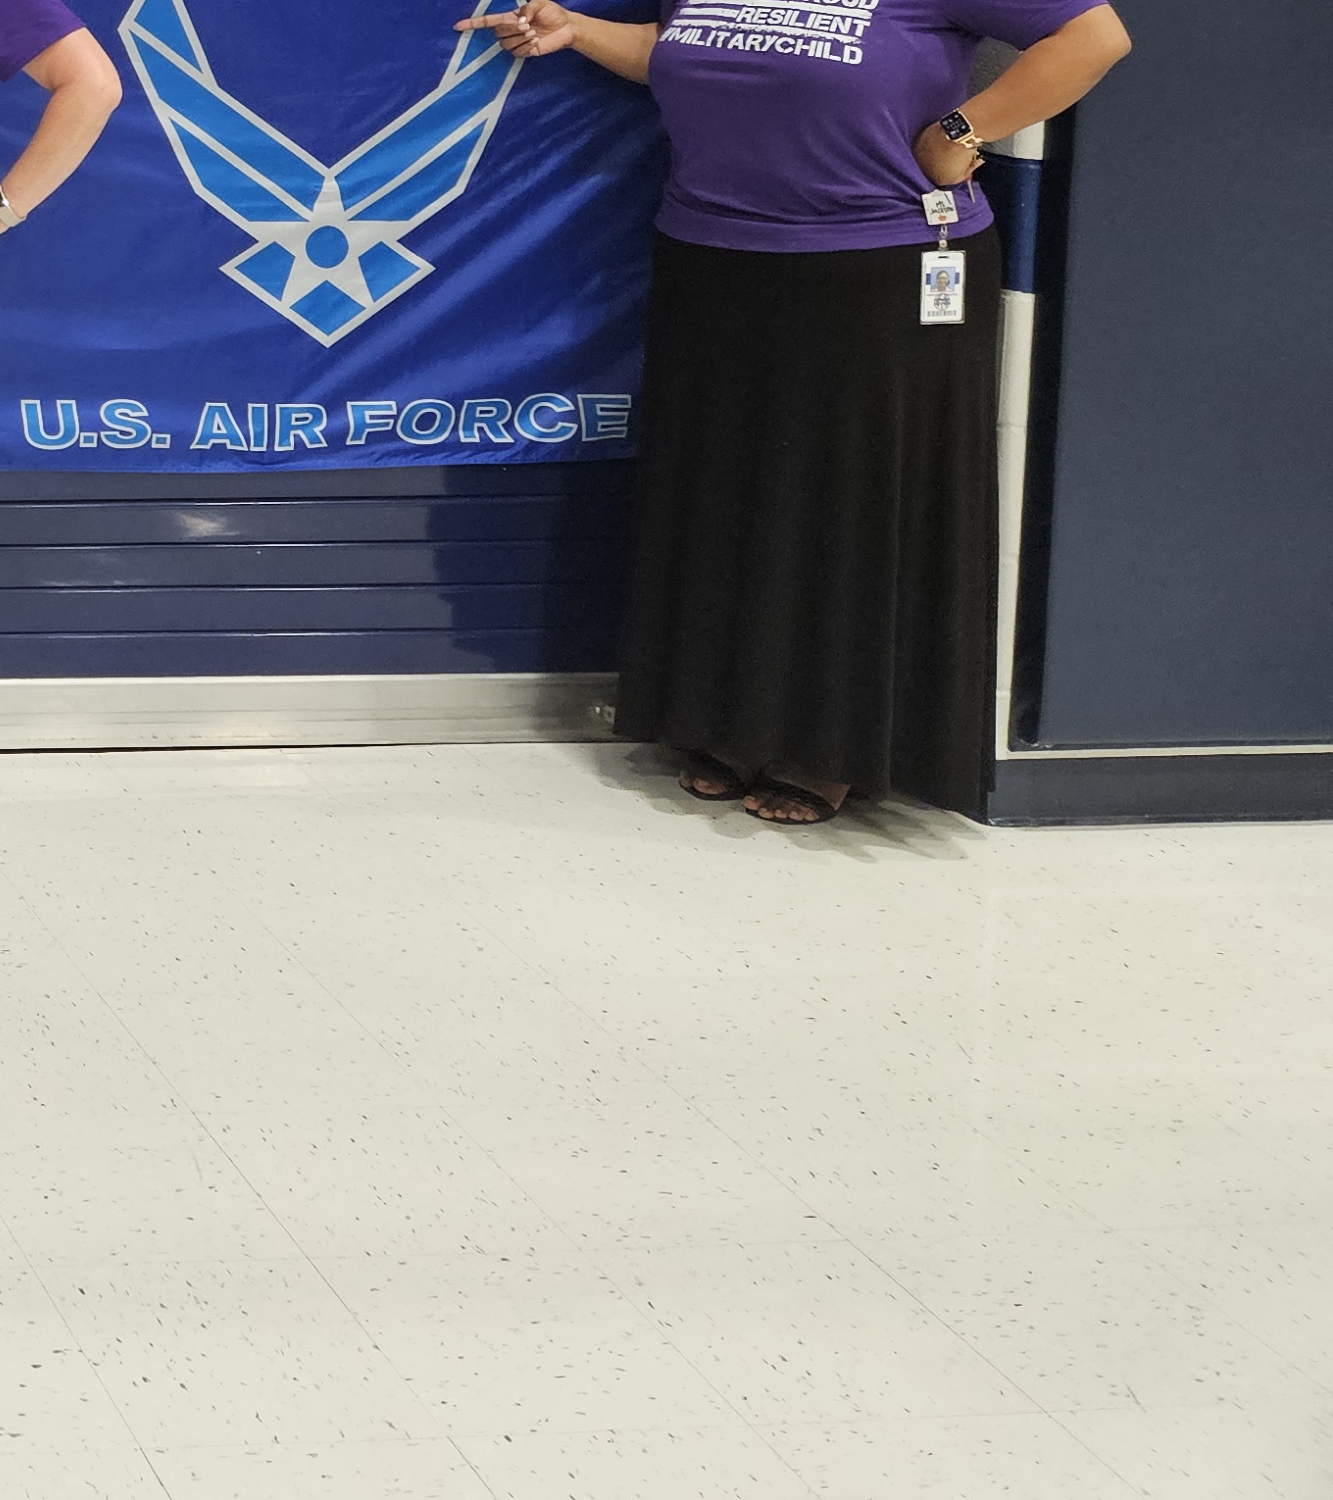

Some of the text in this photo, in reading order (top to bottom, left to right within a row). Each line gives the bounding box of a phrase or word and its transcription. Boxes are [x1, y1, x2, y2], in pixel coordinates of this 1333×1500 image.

[736, 7, 871, 37] RESILIENT
[659, 26, 863, 65] #MILITARYCHILD
[20, 393, 632, 452] U.S. AIR FORCE
